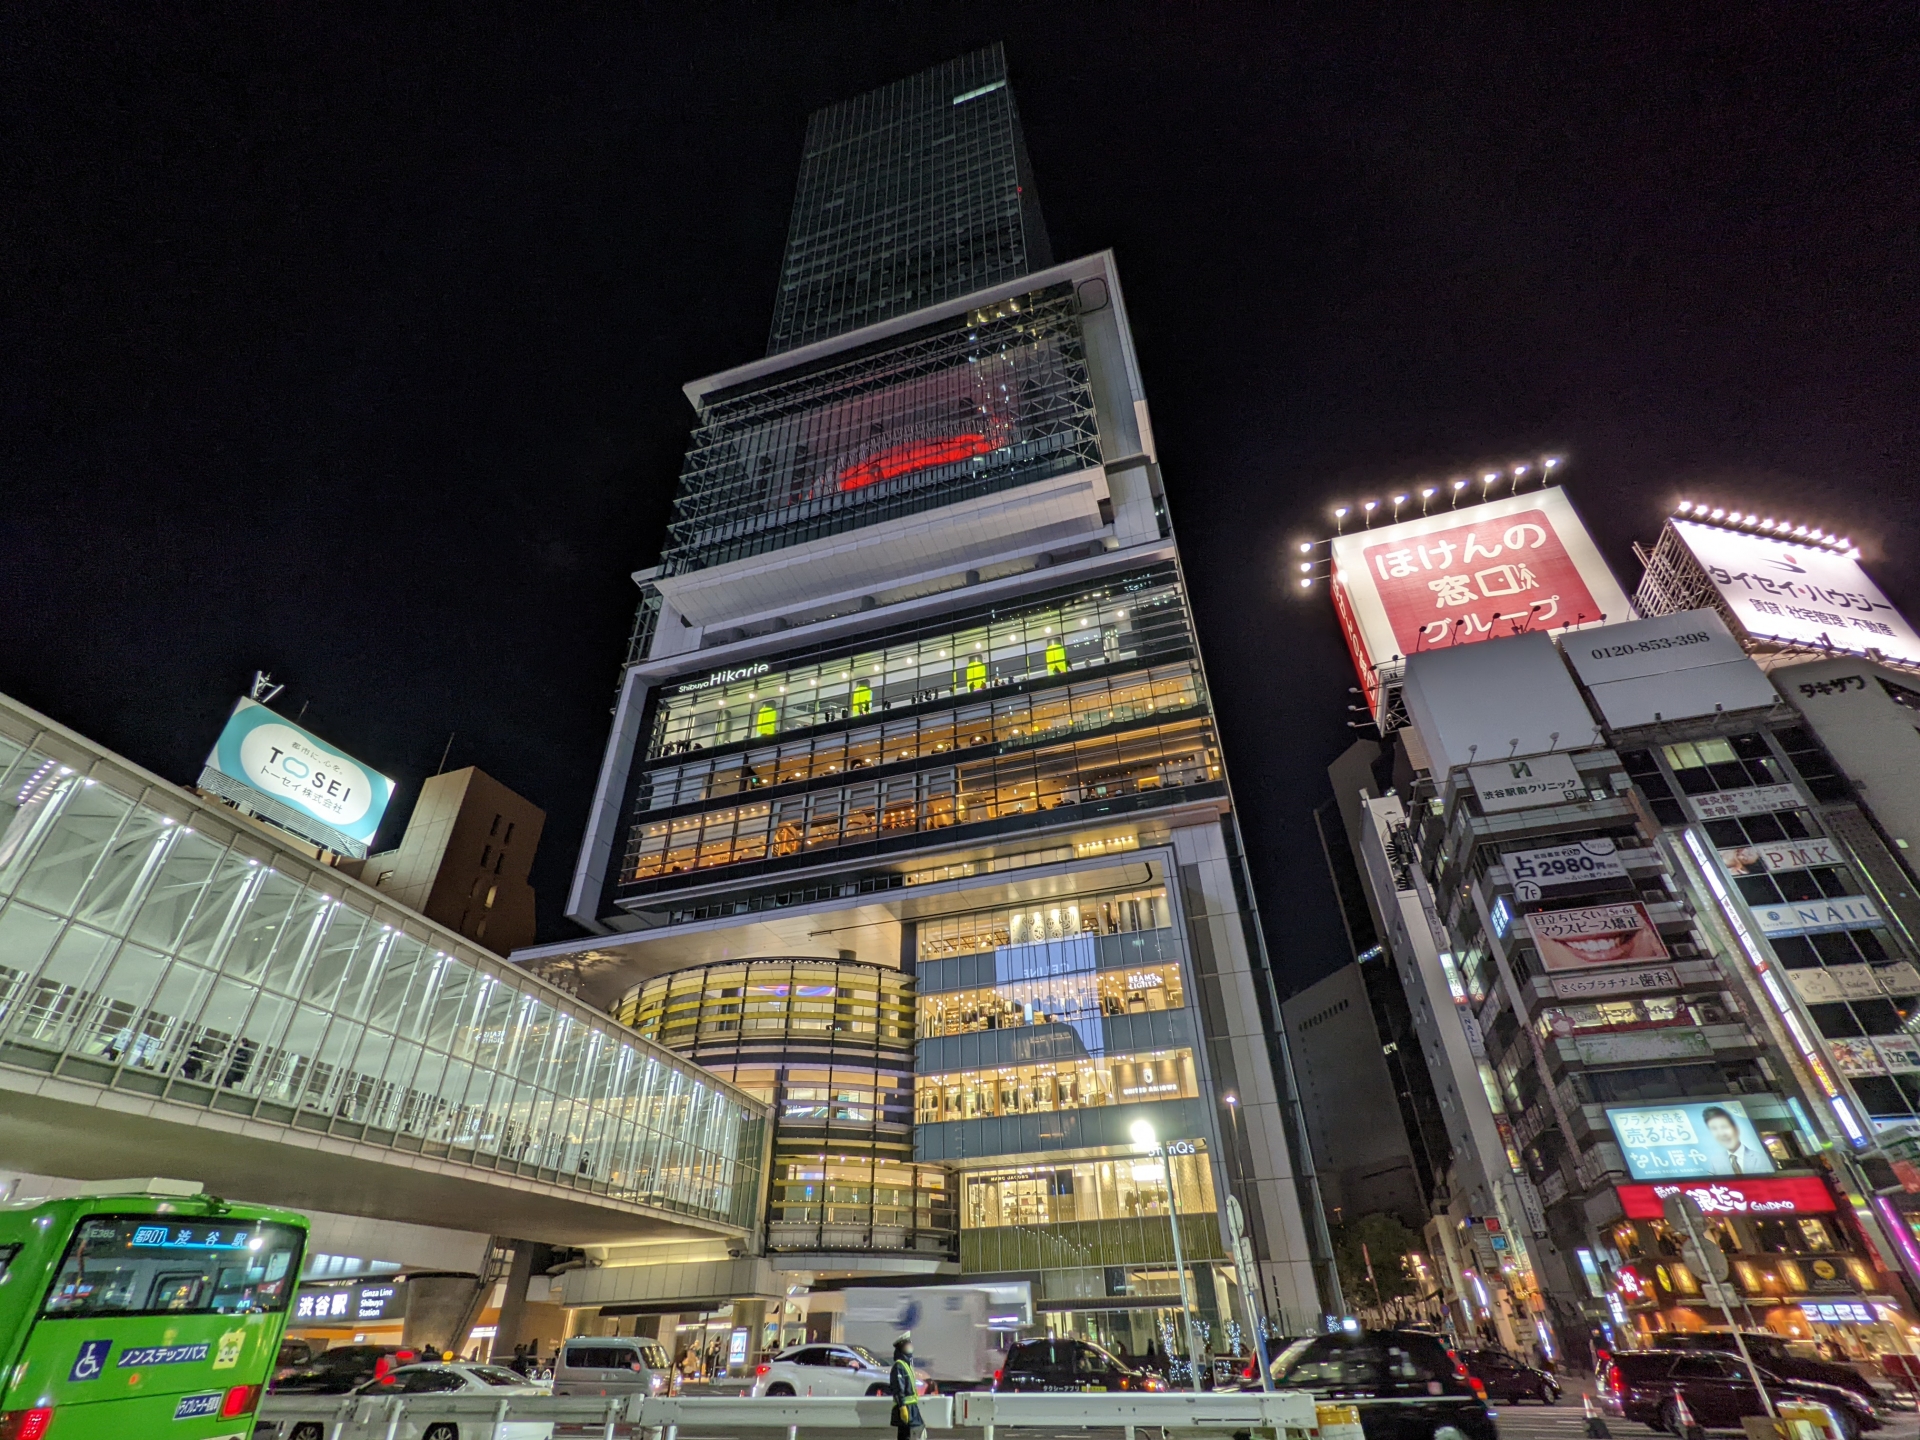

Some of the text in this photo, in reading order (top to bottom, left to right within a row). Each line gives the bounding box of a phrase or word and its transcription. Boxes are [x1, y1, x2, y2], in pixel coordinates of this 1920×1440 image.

[1375, 523, 1546, 580] ほけんの
[1708, 564, 1894, 612] タイセイ・ハウジー
[1423, 595, 1560, 643] グループ
[1749, 598, 1898, 637] 賃貸 社宅管理 不動産
[1590, 631, 1711, 660] 0120-853-398
[678, 663, 769, 693] Shibuya Hikarie
[1799, 675, 1866, 698] タキザワ
[291, 741, 343, 775] 都市に、心を。
[260, 765, 343, 816] トーセイ株式会社
[1482, 778, 1577, 800] 渋谷駅前クリニック
[1513, 855, 1537, 880] 占
[1765, 846, 1837, 869] PMK
[1519, 885, 1538, 900] 7F
[1533, 909, 1602, 927] 目立ちにくい
[1797, 903, 1878, 924] NAIL
[1541, 915, 1641, 938] マウスピース矯正
[1560, 971, 1674, 994] さくらプラチナム歯科
[1619, 1113, 1685, 1126] ブランド品を
[1626, 1126, 1692, 1144] 売るなら
[1750, 1201, 1795, 1211] GINDACO
[135, 1229, 248, 1246] 都01 渋谷駅
[360, 1299, 384, 1308] Shibuya
[361, 1288, 393, 1298] Ginza Line
[298, 1293, 348, 1317] 渋谷駅
[358, 1308, 380, 1317] Station
[118, 1345, 208, 1366] ノンステップバス
[1043, 1384, 1080, 1392] タクシーアプリ
